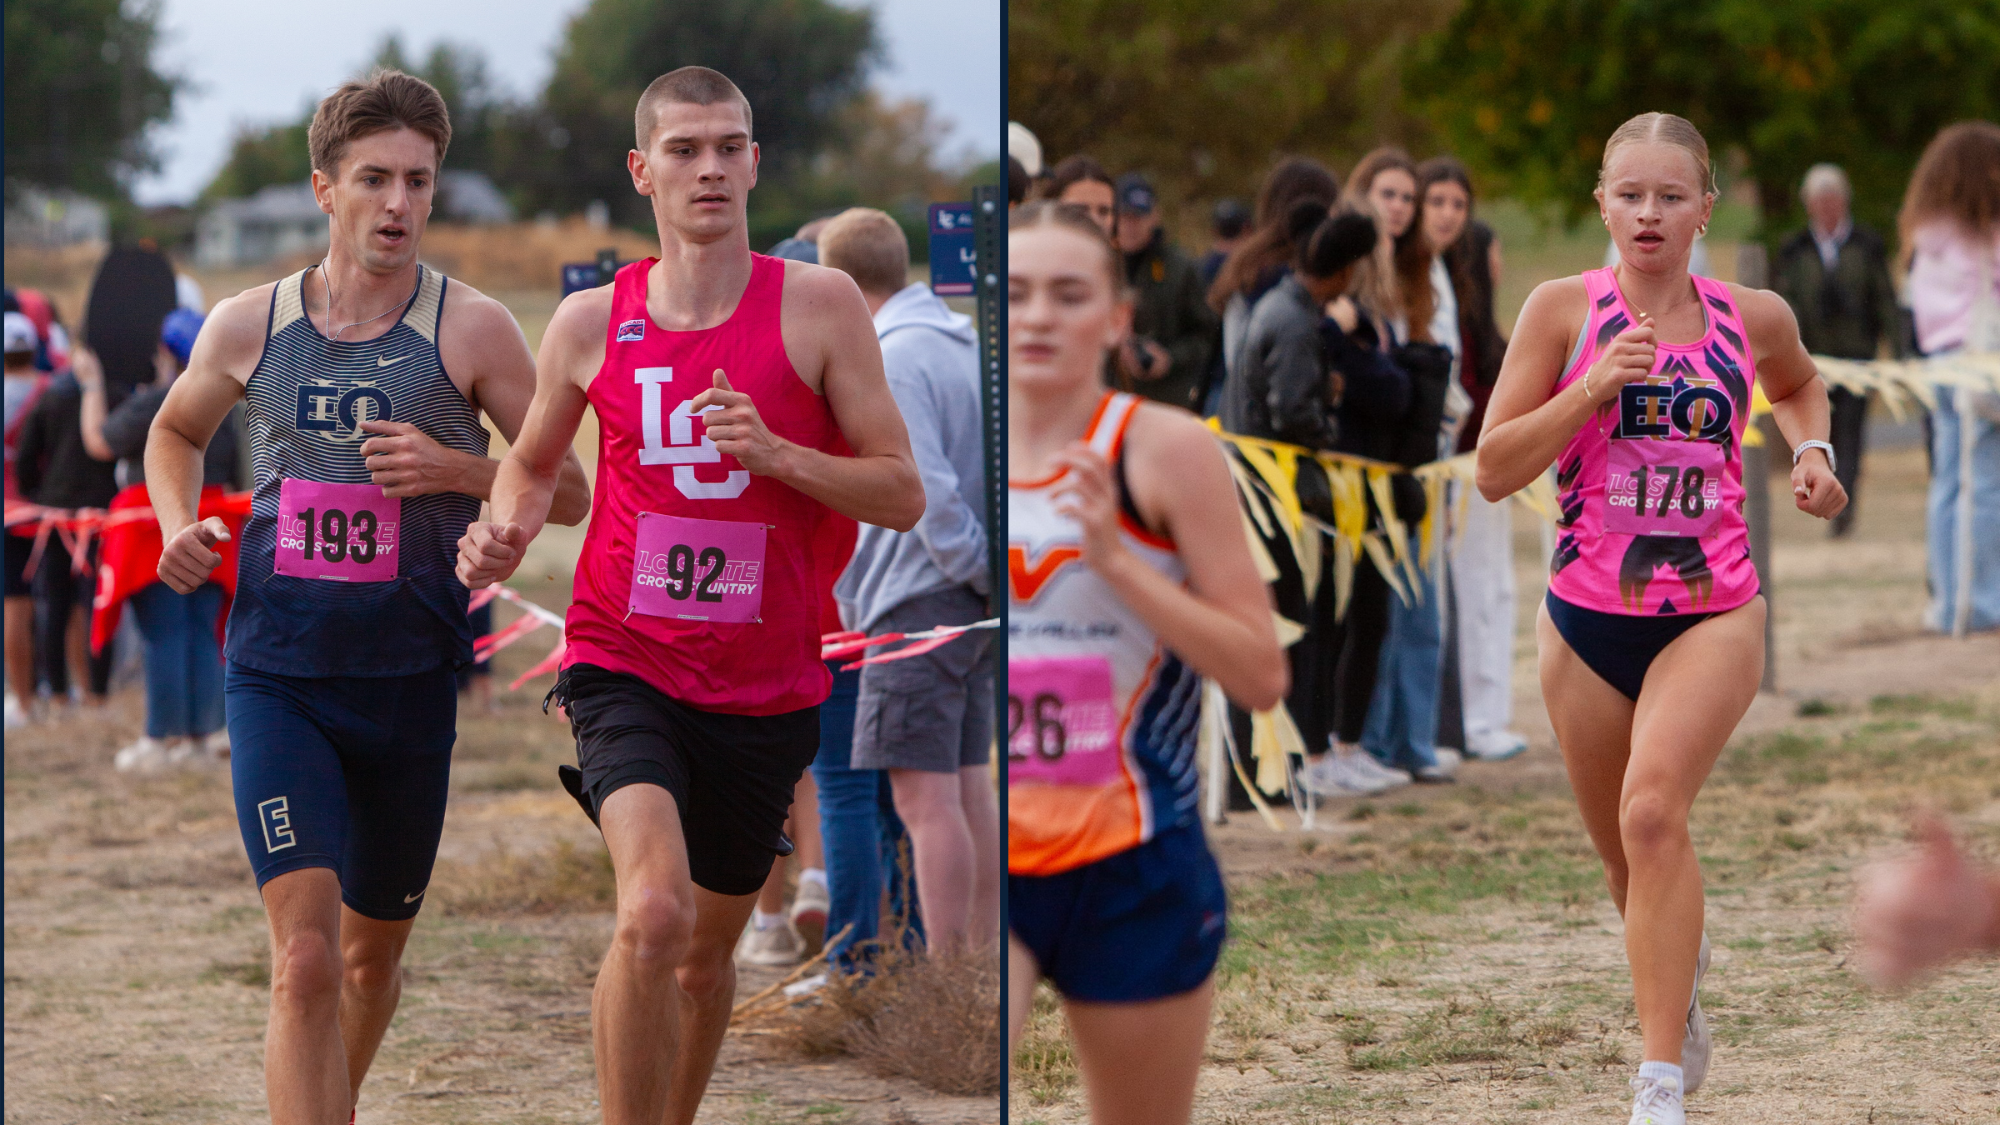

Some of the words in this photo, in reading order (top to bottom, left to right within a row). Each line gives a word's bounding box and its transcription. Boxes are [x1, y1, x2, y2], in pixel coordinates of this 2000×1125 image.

[620, 325, 642, 335] CCC
[1608, 495, 1655, 509] CROS
[1656, 498, 1720, 511] OUNRY
[1629, 465, 1705, 519] 178
[280, 537, 322, 552] CROS
[297, 507, 378, 564] 193
[666, 544, 726, 602] 92
[689, 581, 758, 595] UNTRY
[257, 796, 297, 854] E
